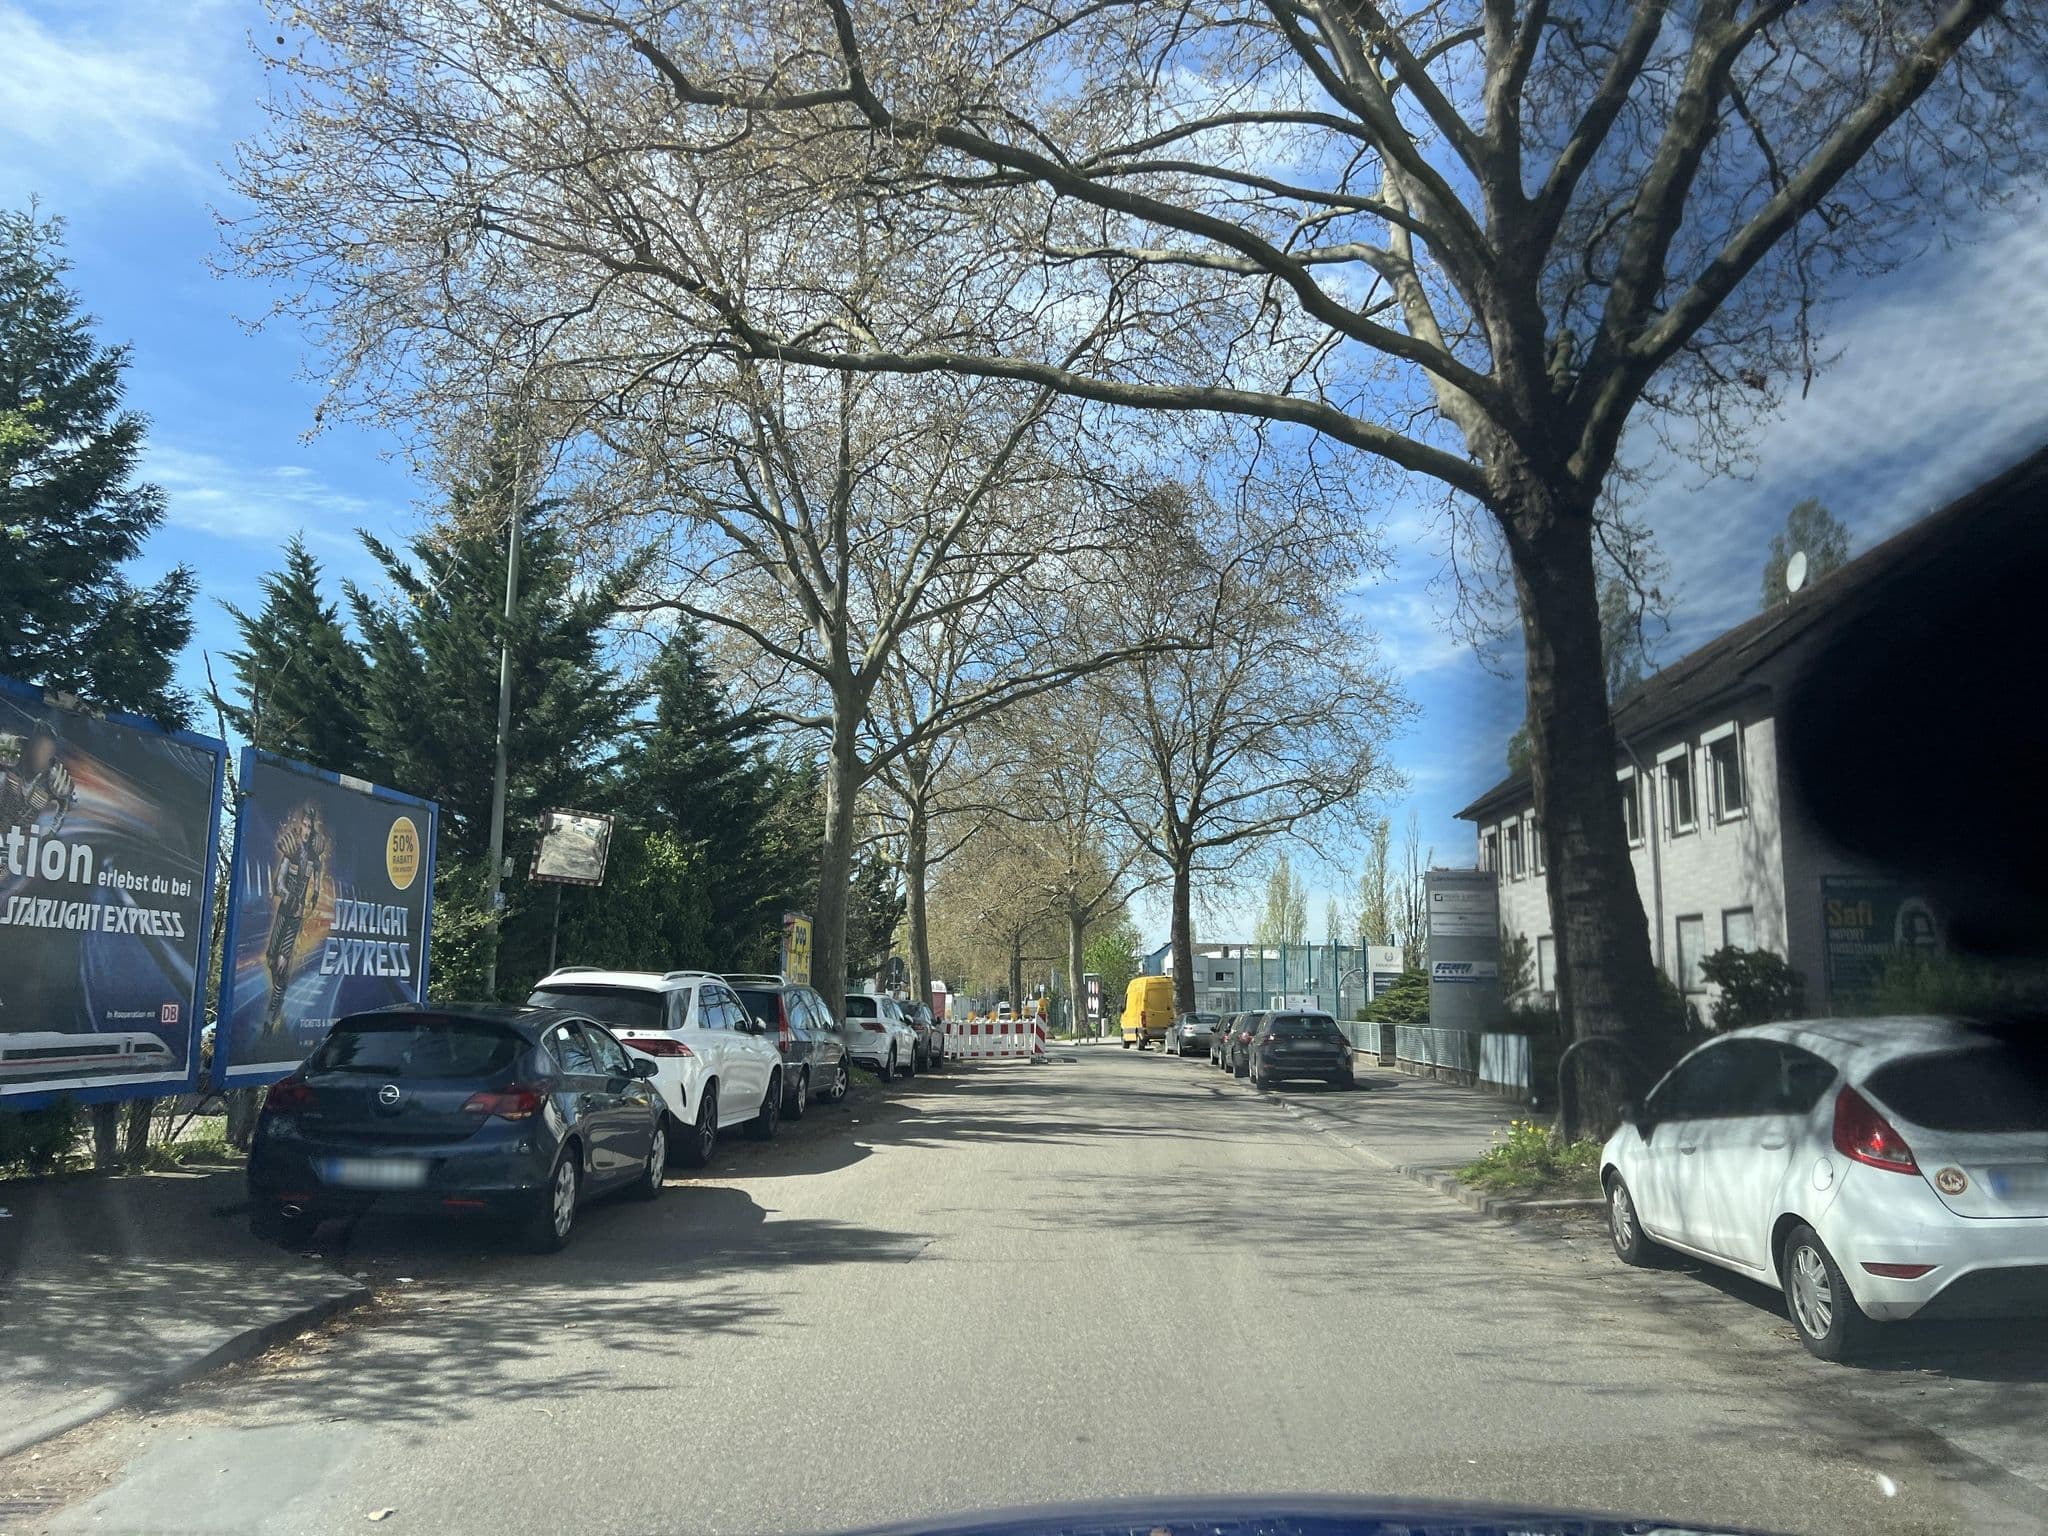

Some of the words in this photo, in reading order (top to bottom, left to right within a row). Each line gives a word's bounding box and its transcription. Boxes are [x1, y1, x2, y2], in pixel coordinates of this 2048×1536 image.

[0, 824, 93, 884] tion
[98, 869, 149, 891] erlebst
[152, 875, 168, 894] du
[172, 878, 192, 897] bei
[393, 834, 414, 853] 50%
[393, 855, 413, 865] RABATT
[0, 896, 100, 931] STARLIGHT
[102, 905, 185, 938] EXPRESS
[330, 898, 409, 936] STARLIGHT
[320, 937, 411, 977] EXPRESS
[163, 1006, 178, 1021] DB
